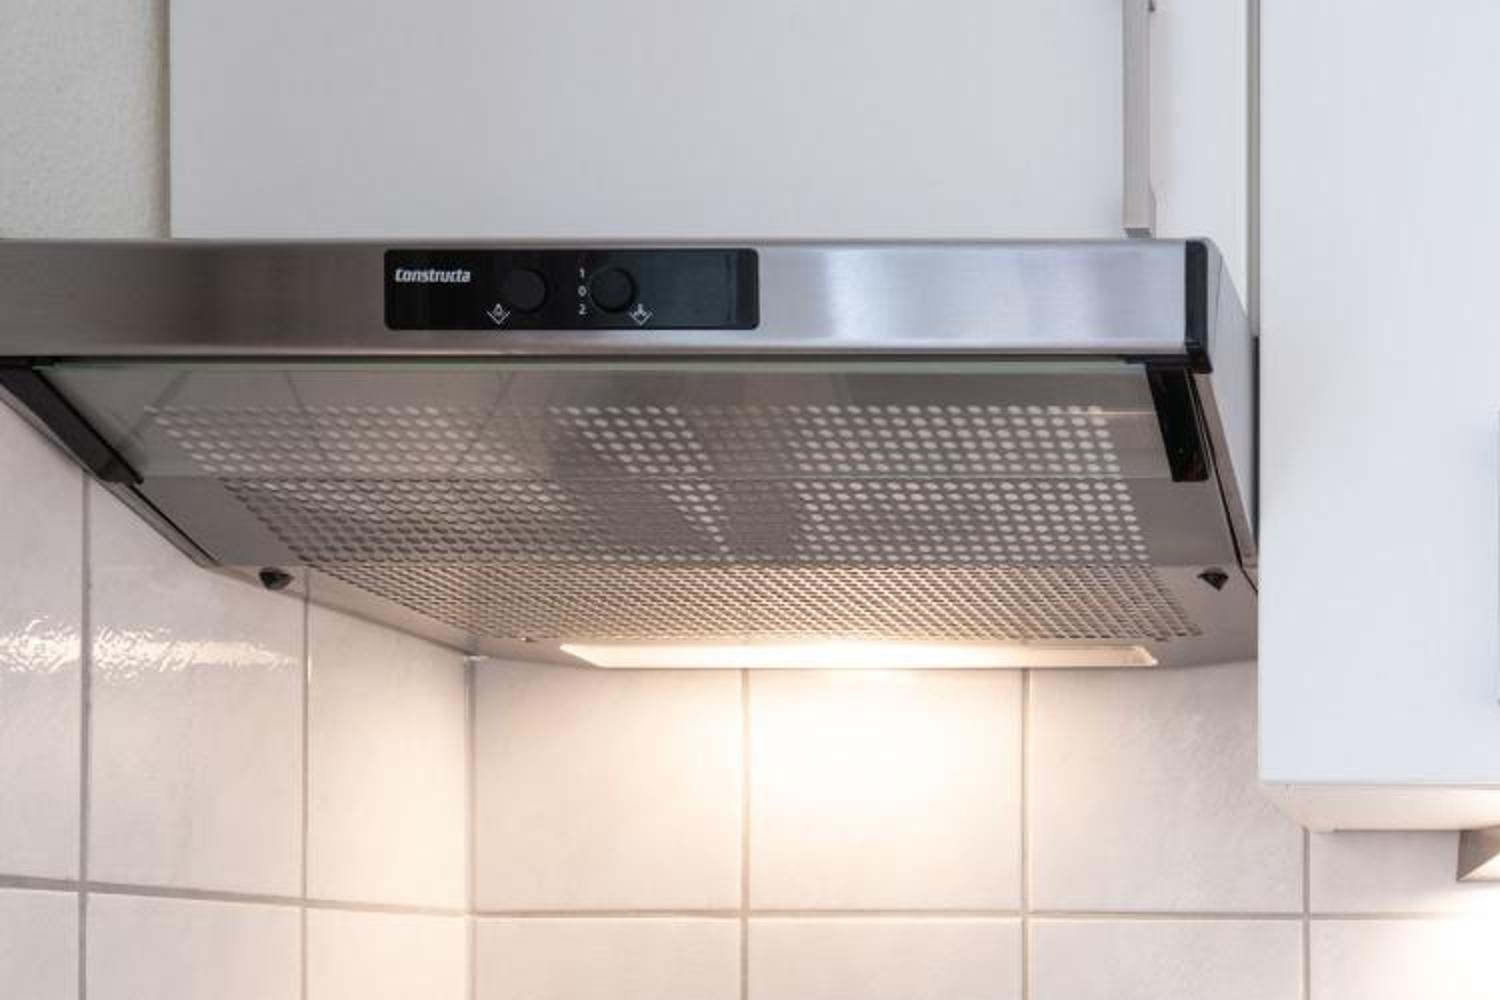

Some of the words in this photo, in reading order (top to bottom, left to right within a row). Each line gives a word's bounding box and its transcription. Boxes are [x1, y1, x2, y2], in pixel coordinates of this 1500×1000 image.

[395, 268, 471, 283] Constructa
[579, 268, 585, 278] 1
[578, 304, 587, 315] 2
